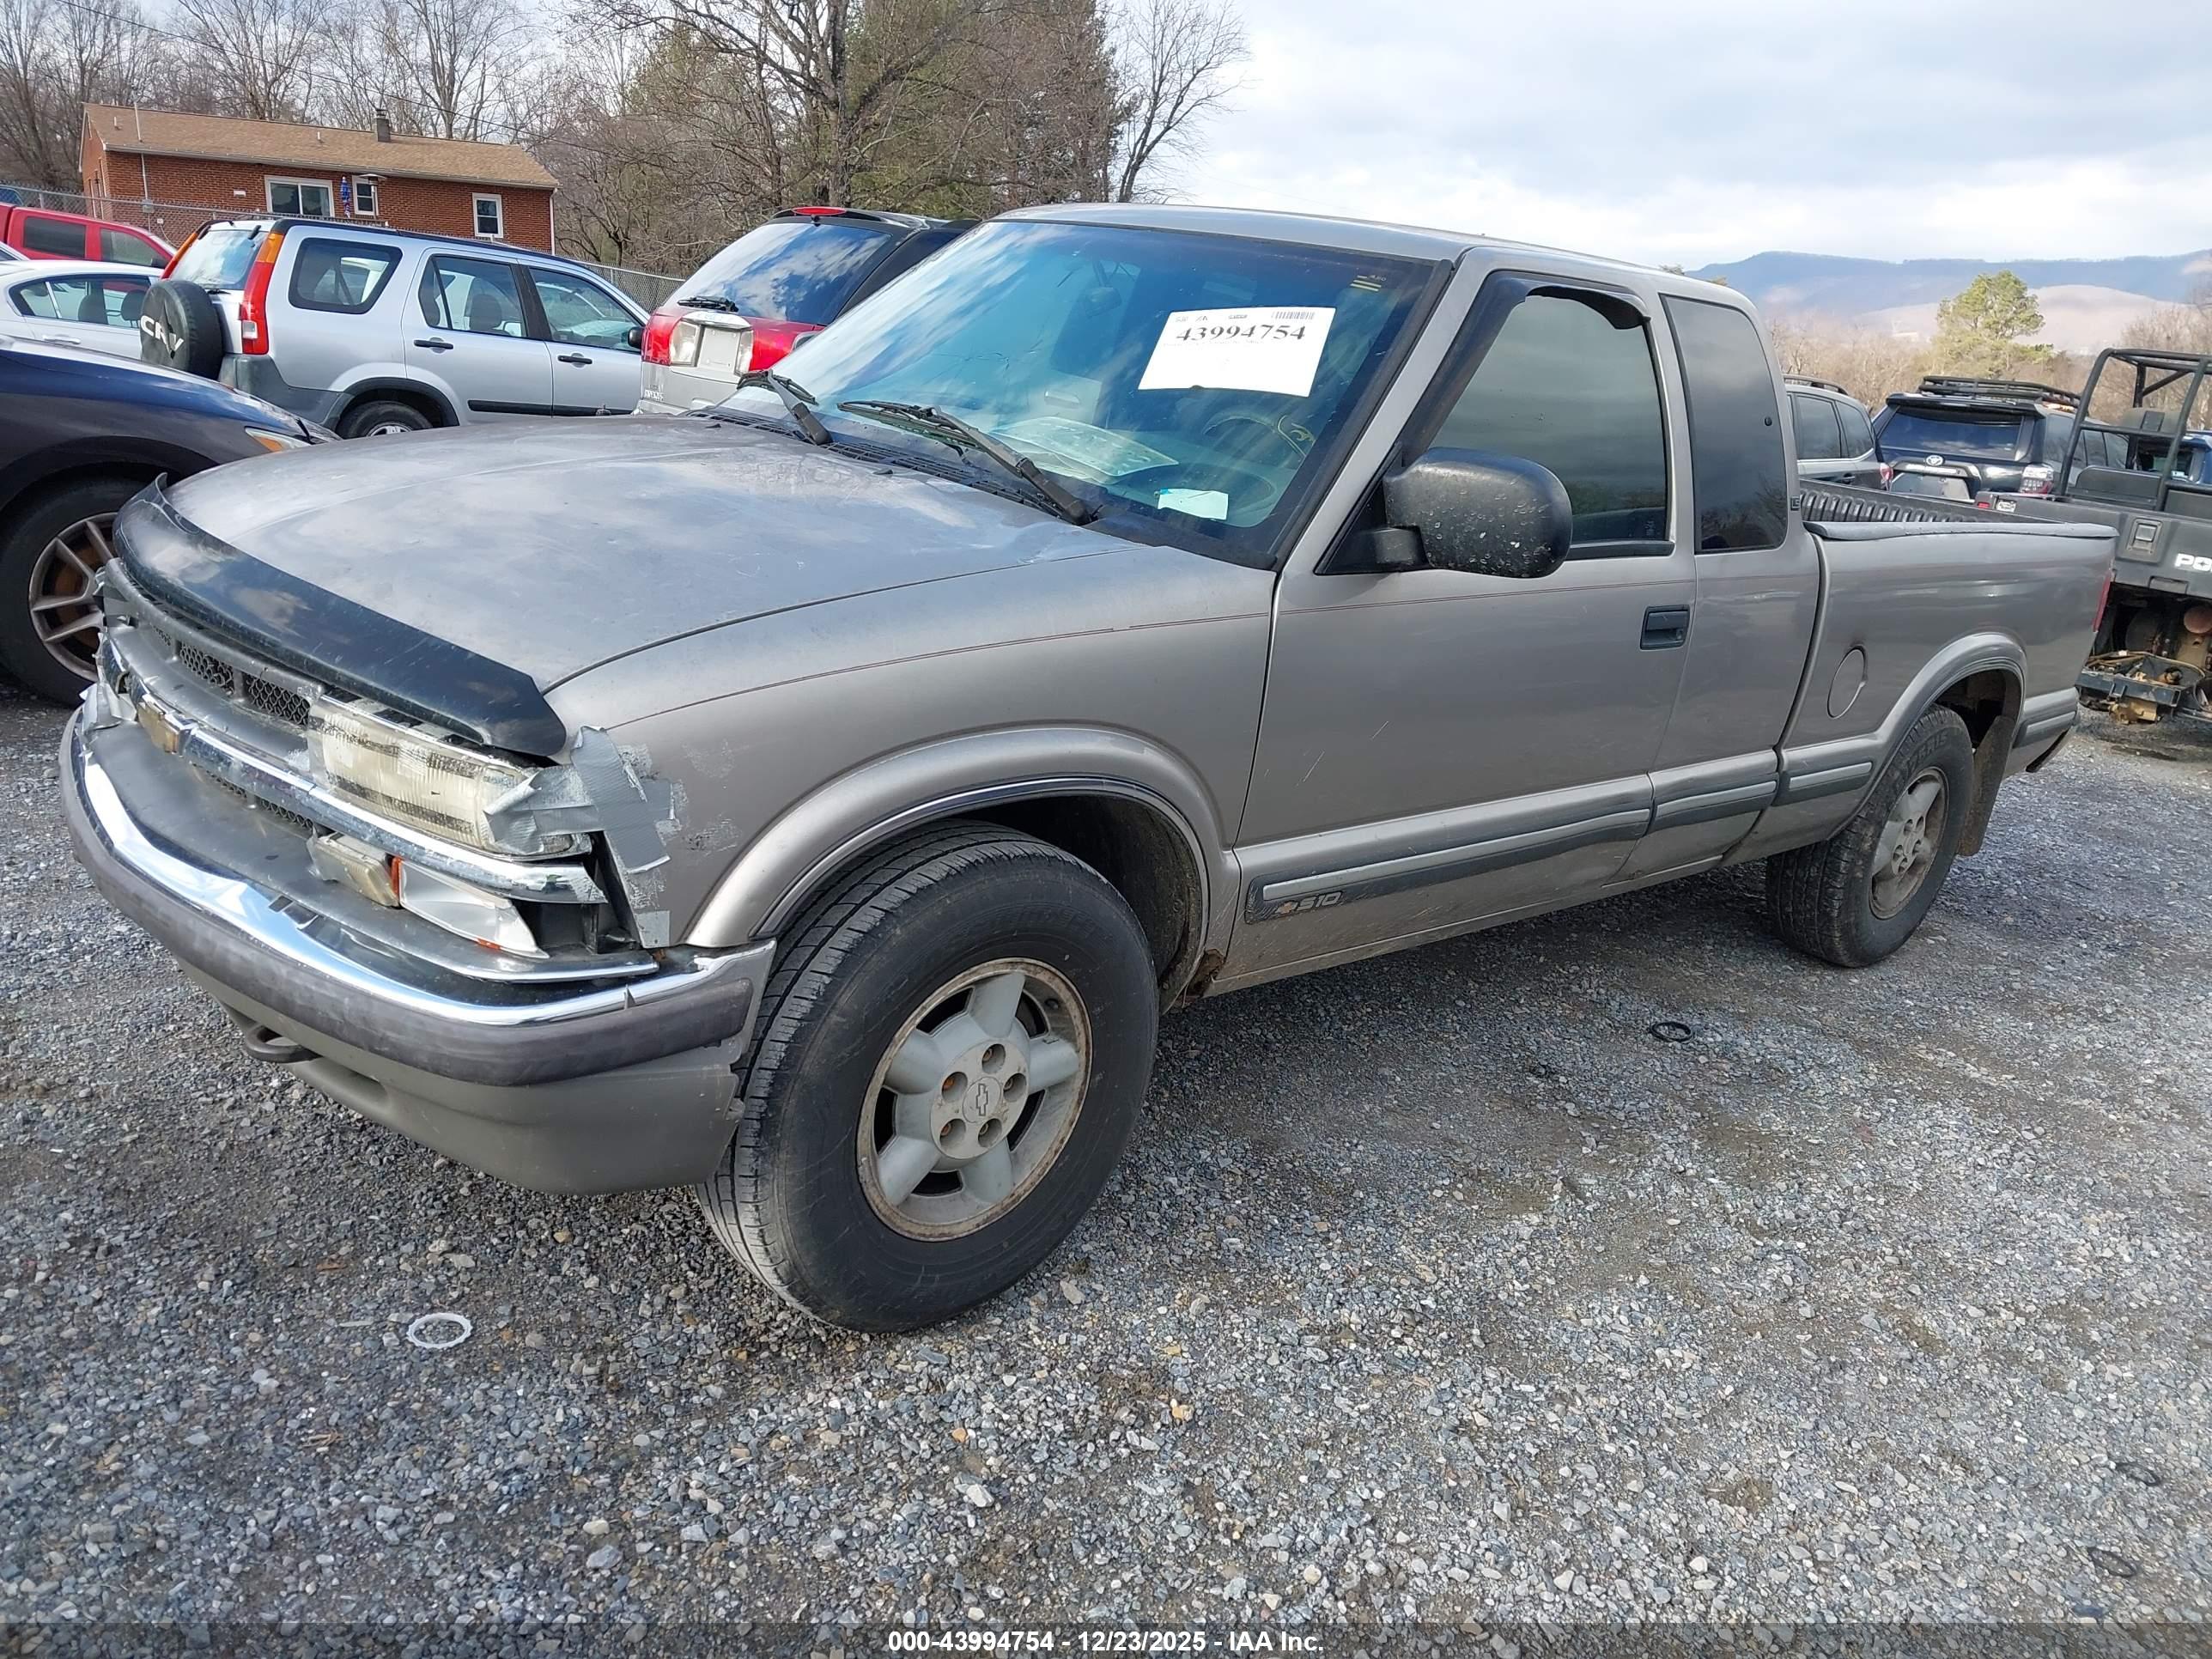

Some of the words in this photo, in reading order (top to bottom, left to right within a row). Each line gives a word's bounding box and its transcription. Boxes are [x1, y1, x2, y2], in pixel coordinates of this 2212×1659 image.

[1176, 324, 1306, 342] 43994754
[2174, 553, 2212, 574] PO
[1297, 891, 1342, 911] S10
